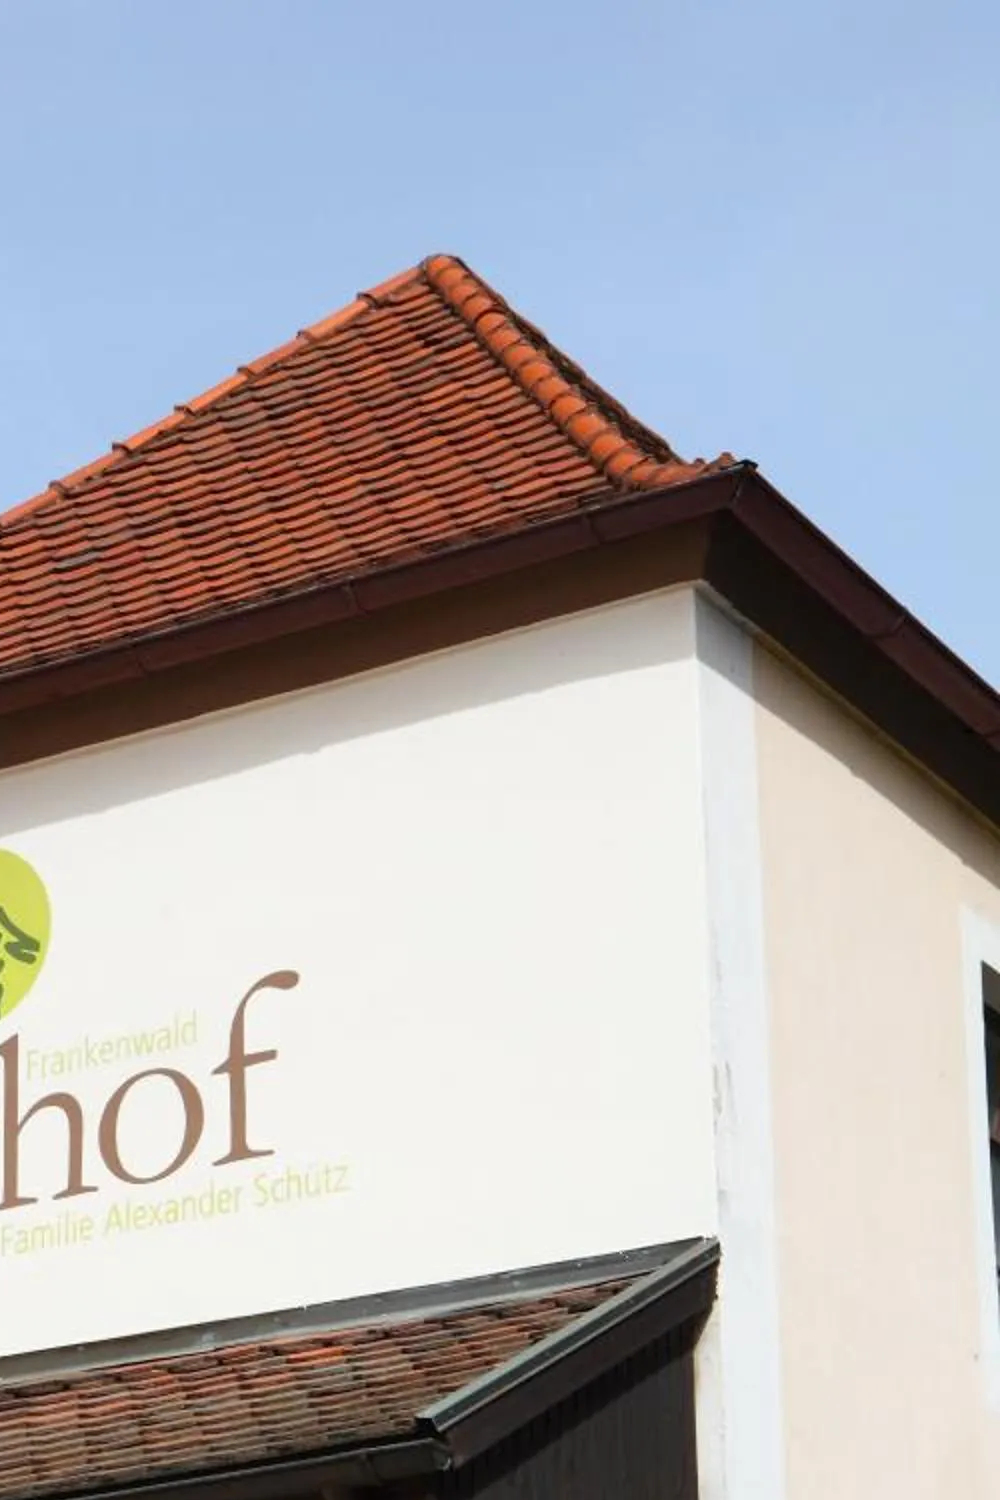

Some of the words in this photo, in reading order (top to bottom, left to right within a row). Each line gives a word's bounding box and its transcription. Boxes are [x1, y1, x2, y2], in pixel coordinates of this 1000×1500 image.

[26, 1010, 199, 1081] Frankenwald
[0, 1209, 95, 1257] Familie
[103, 1178, 243, 1236] Alexander
[252, 1161, 350, 1208] Schütz
